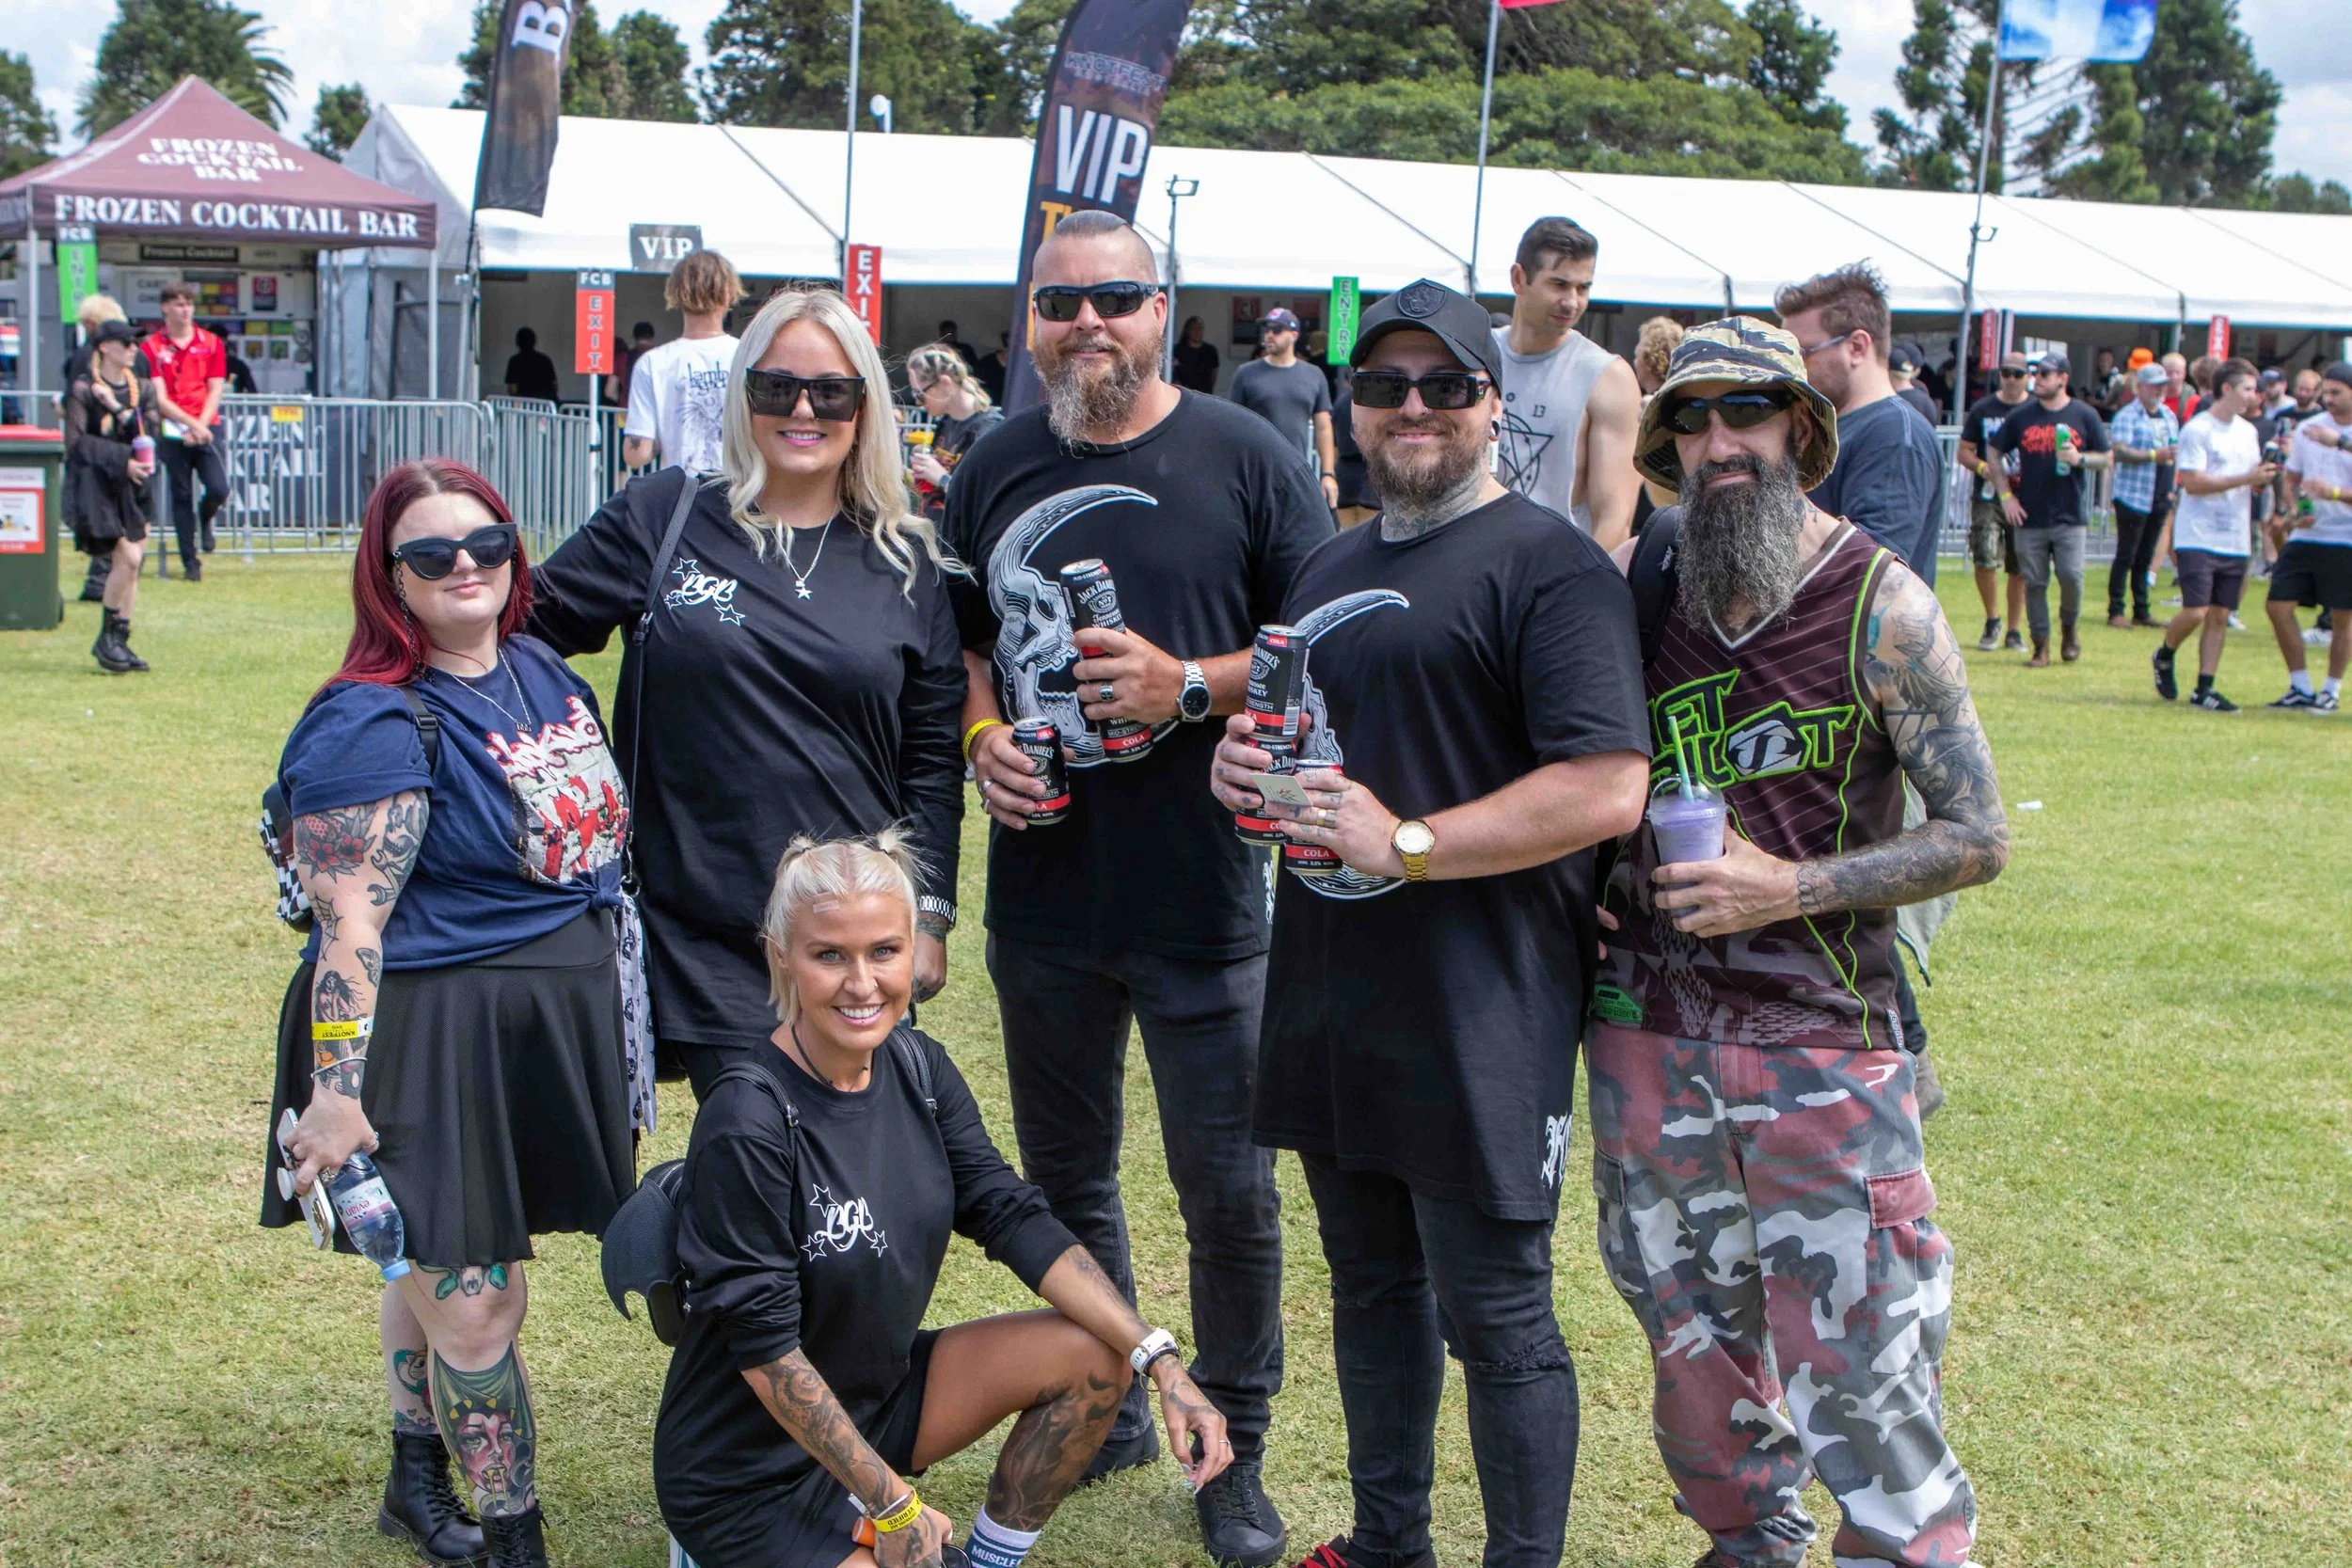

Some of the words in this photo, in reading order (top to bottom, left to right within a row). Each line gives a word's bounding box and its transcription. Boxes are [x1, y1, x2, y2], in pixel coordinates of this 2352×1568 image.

[150, 137, 279, 157] FROZEN
[1056, 104, 1150, 204] VIP
[137, 152, 305, 172] COCKTAIL
[194, 166, 262, 182] BAR
[55, 194, 182, 226] FROZEN
[191, 200, 350, 235] COCKTAIL
[358, 210, 420, 238] BAR
[638, 235, 693, 261] VIP
[580, 271, 612, 286] FCB
[1337, 278, 1352, 362] ENTRY
[587, 294, 604, 369] EXIT
[1077, 584, 1099, 605] JACK
[1022, 742, 1055, 760] DANIEL'S
[1122, 735, 1145, 748] COLA
[1303, 848, 1330, 858] COLA
[322, 1030, 356, 1038] KNOTFEST
[345, 1199, 371, 1217] evian
[887, 1506, 915, 1526] VERIFIED
